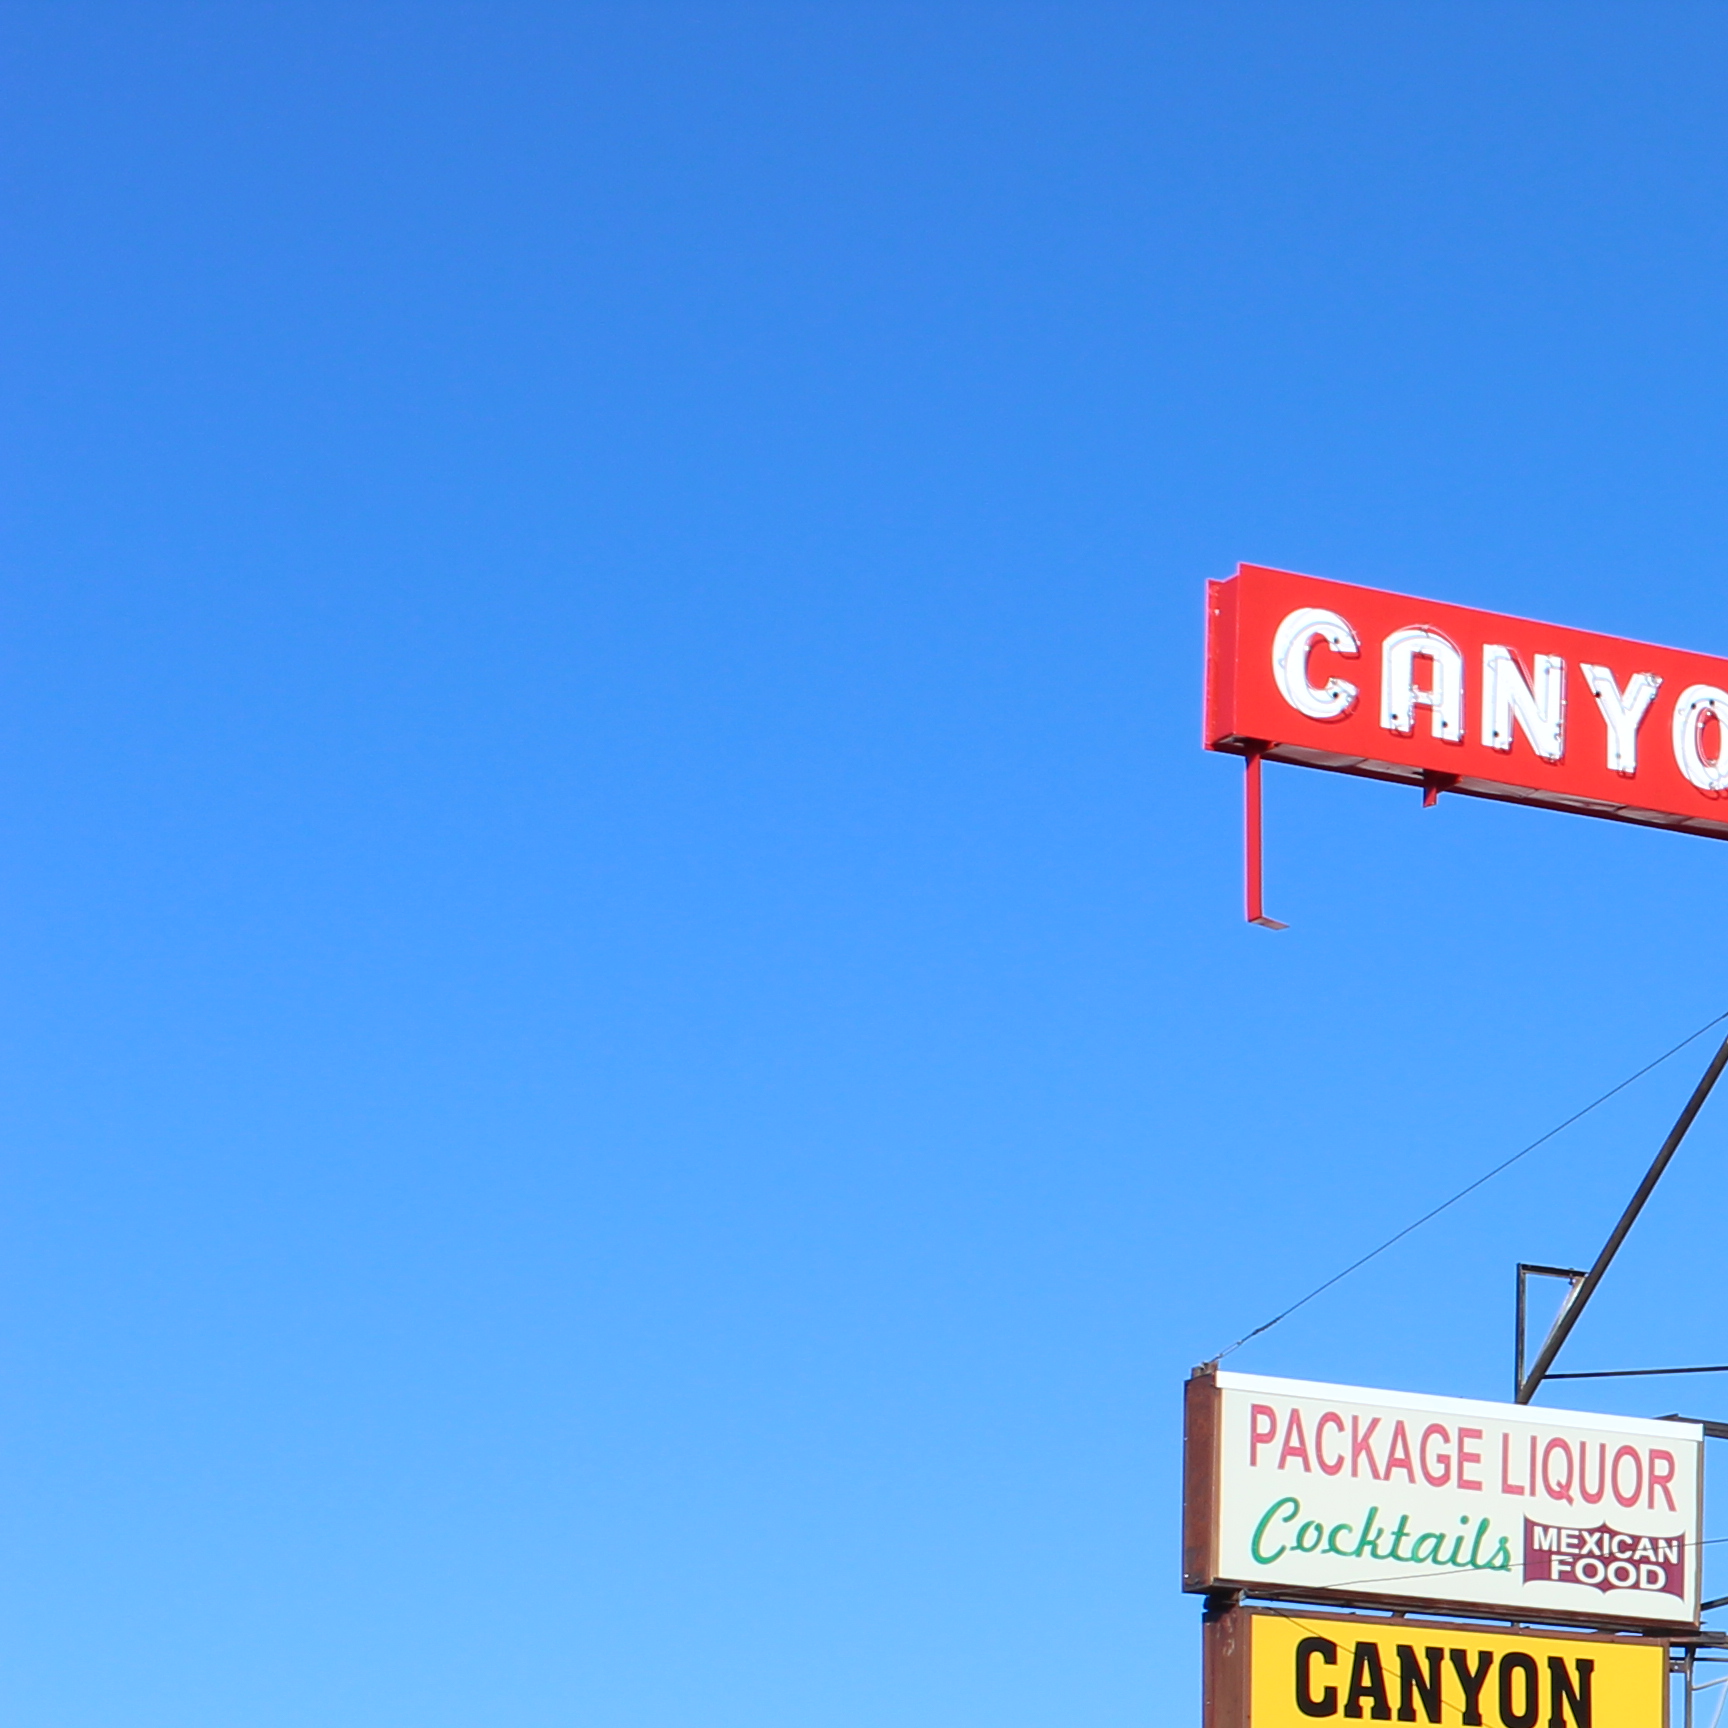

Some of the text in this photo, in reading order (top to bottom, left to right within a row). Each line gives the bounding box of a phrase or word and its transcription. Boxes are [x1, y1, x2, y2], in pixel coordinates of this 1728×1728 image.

[1249, 1402, 1678, 1513] PACKAGE LIQUOR
[1250, 1496, 1513, 1573] Cocktails
[1532, 1524, 1680, 1566] MEXICAN
[1549, 1553, 1669, 1592] FOOD
